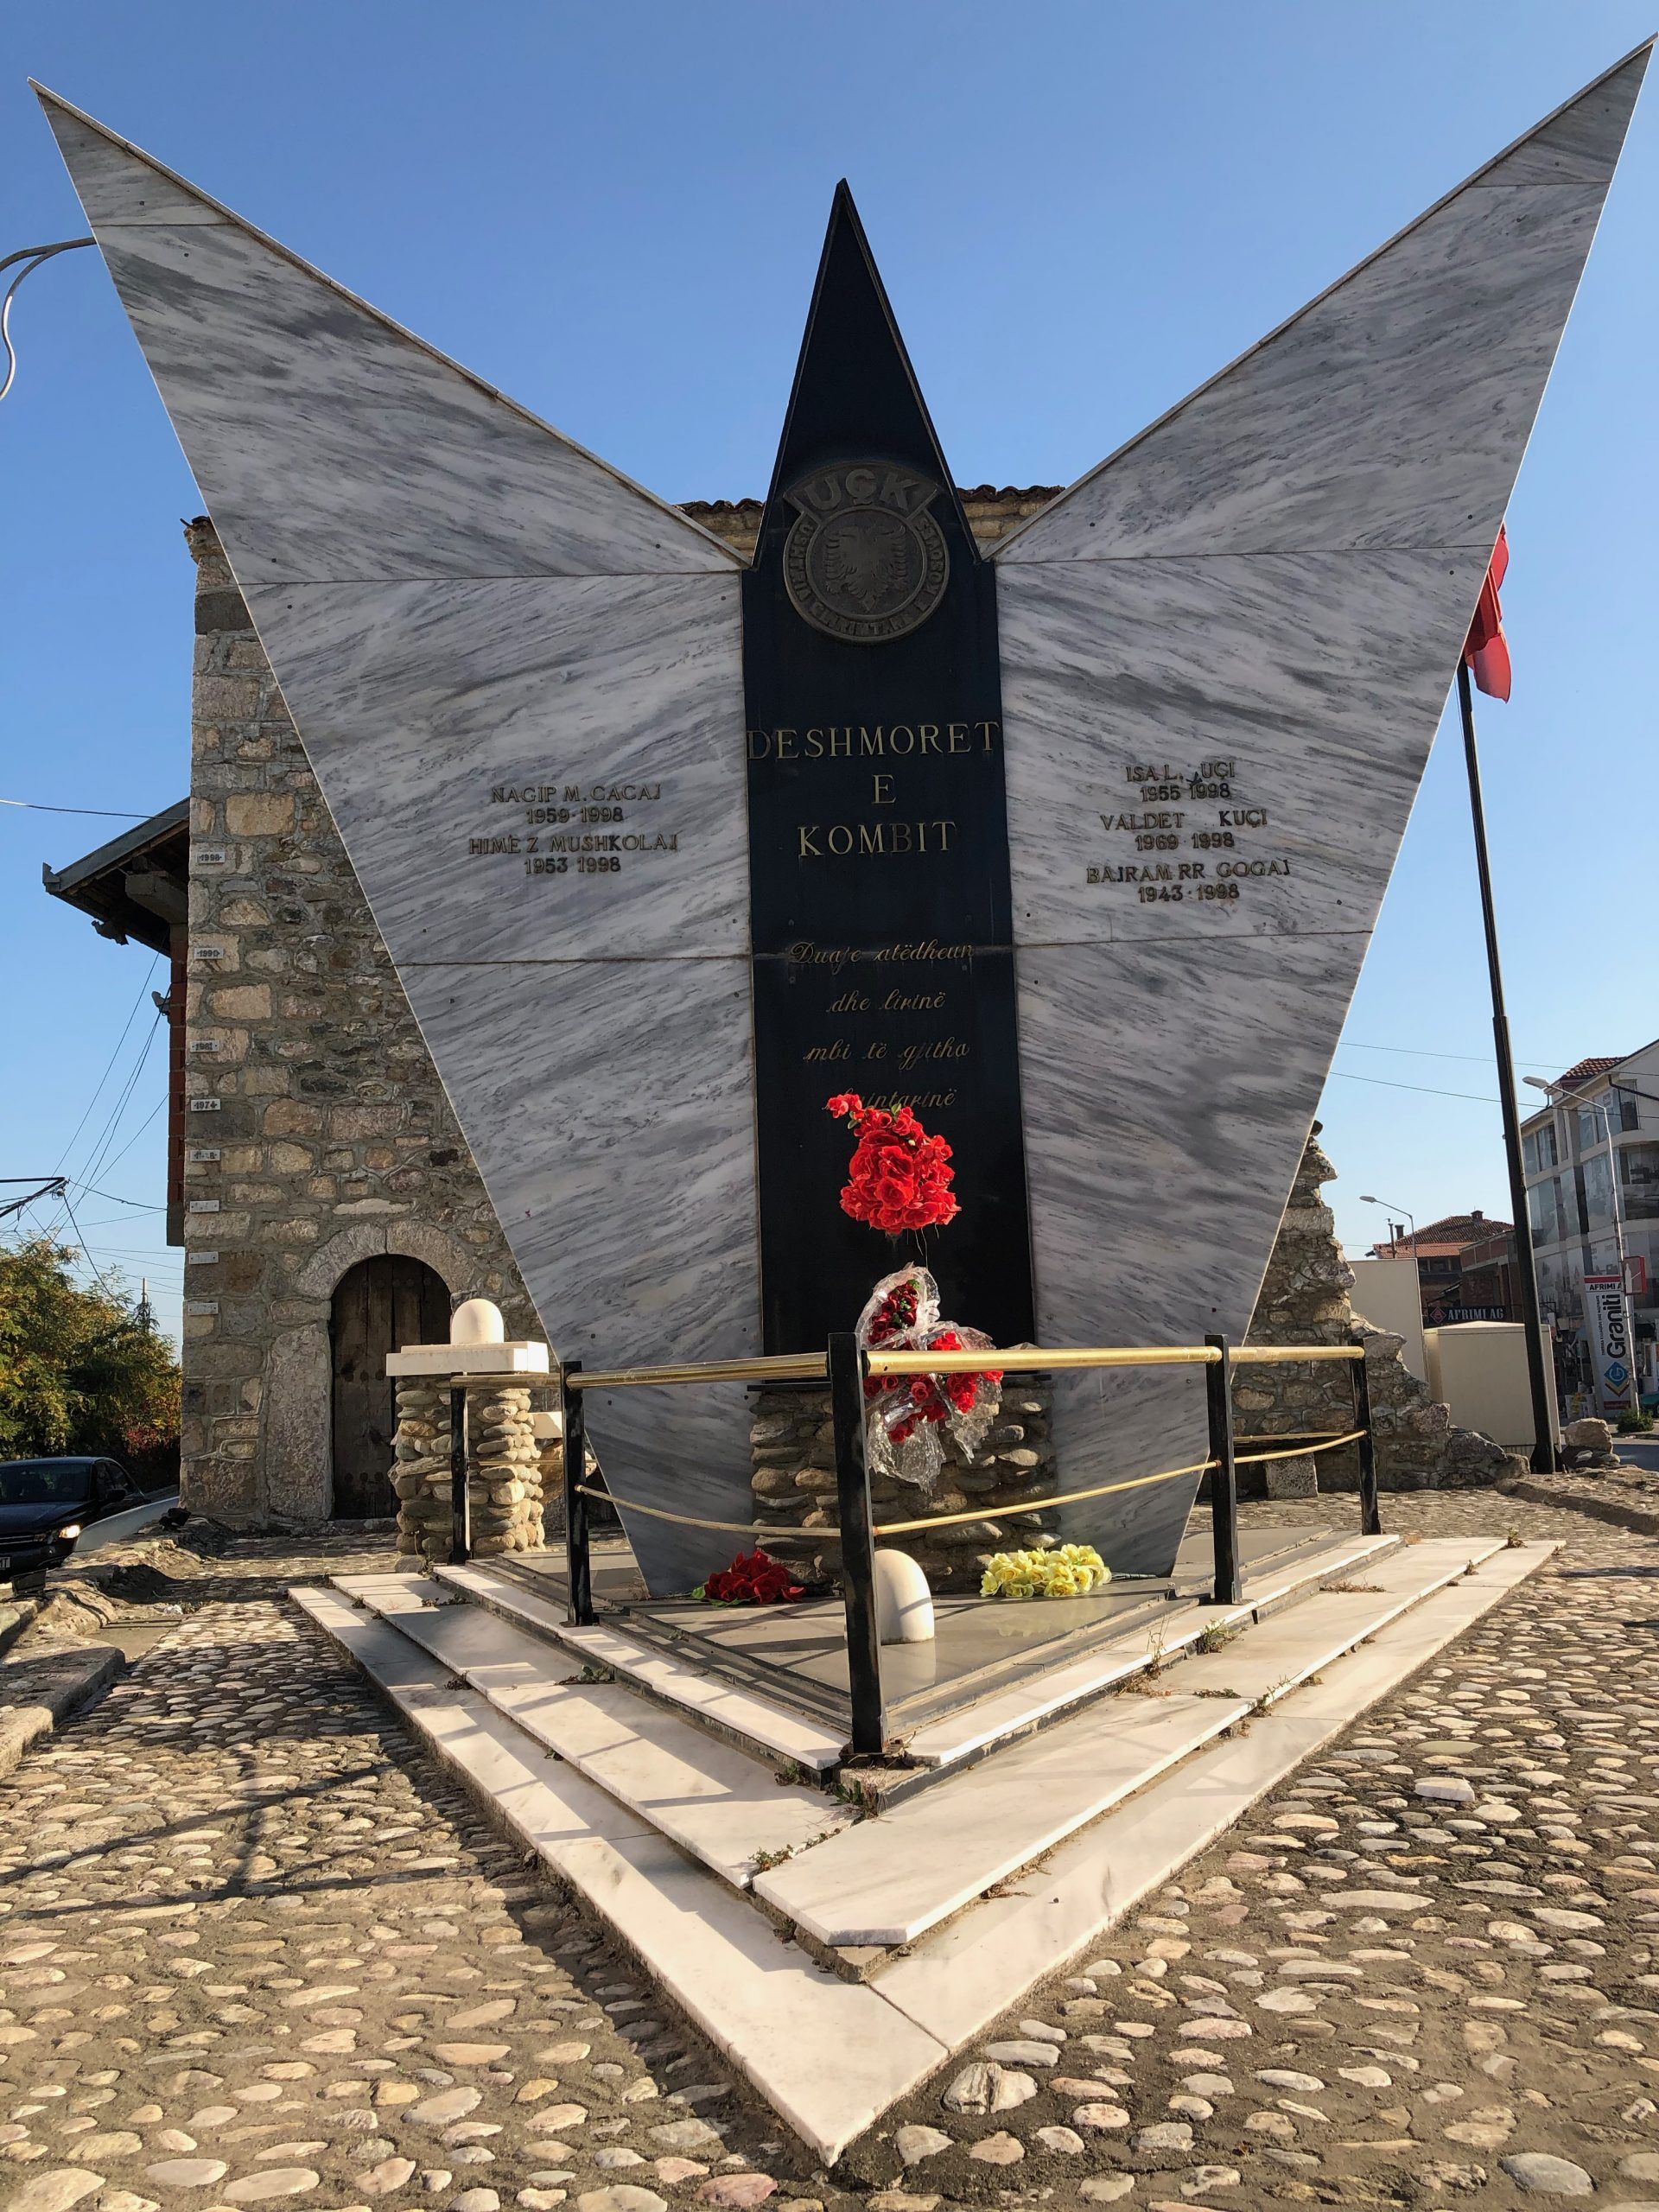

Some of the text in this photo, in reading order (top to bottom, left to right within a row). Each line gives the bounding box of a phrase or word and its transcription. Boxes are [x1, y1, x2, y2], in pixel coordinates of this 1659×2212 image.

[804, 467, 920, 512] UÇK
[746, 721, 1001, 760] DESHMORET
[1126, 766, 1159, 783] ISA
[491, 785, 557, 804] NAGIP
[871, 774, 896, 804] E
[1140, 782, 1232, 803] 1955 1998
[1100, 809, 1268, 831] VALDET KUÇI
[797, 821, 957, 857] KOMBIT
[1135, 831, 1236, 851] 1969 1998
[524, 856, 621, 874] 1953 1998
[1086, 863, 1173, 884] BAJRAM
[1137, 883, 1240, 903] 1943 1998
[826, 988, 947, 1013] dhe lirinë
[803, 1036, 970, 1071] mbi të gjitha
[1589, 1282, 1617, 1291] AFRIMI
[1447, 1307, 1504, 1320] AFRIMI AG
[1601, 1294, 1626, 1359] Graniti
